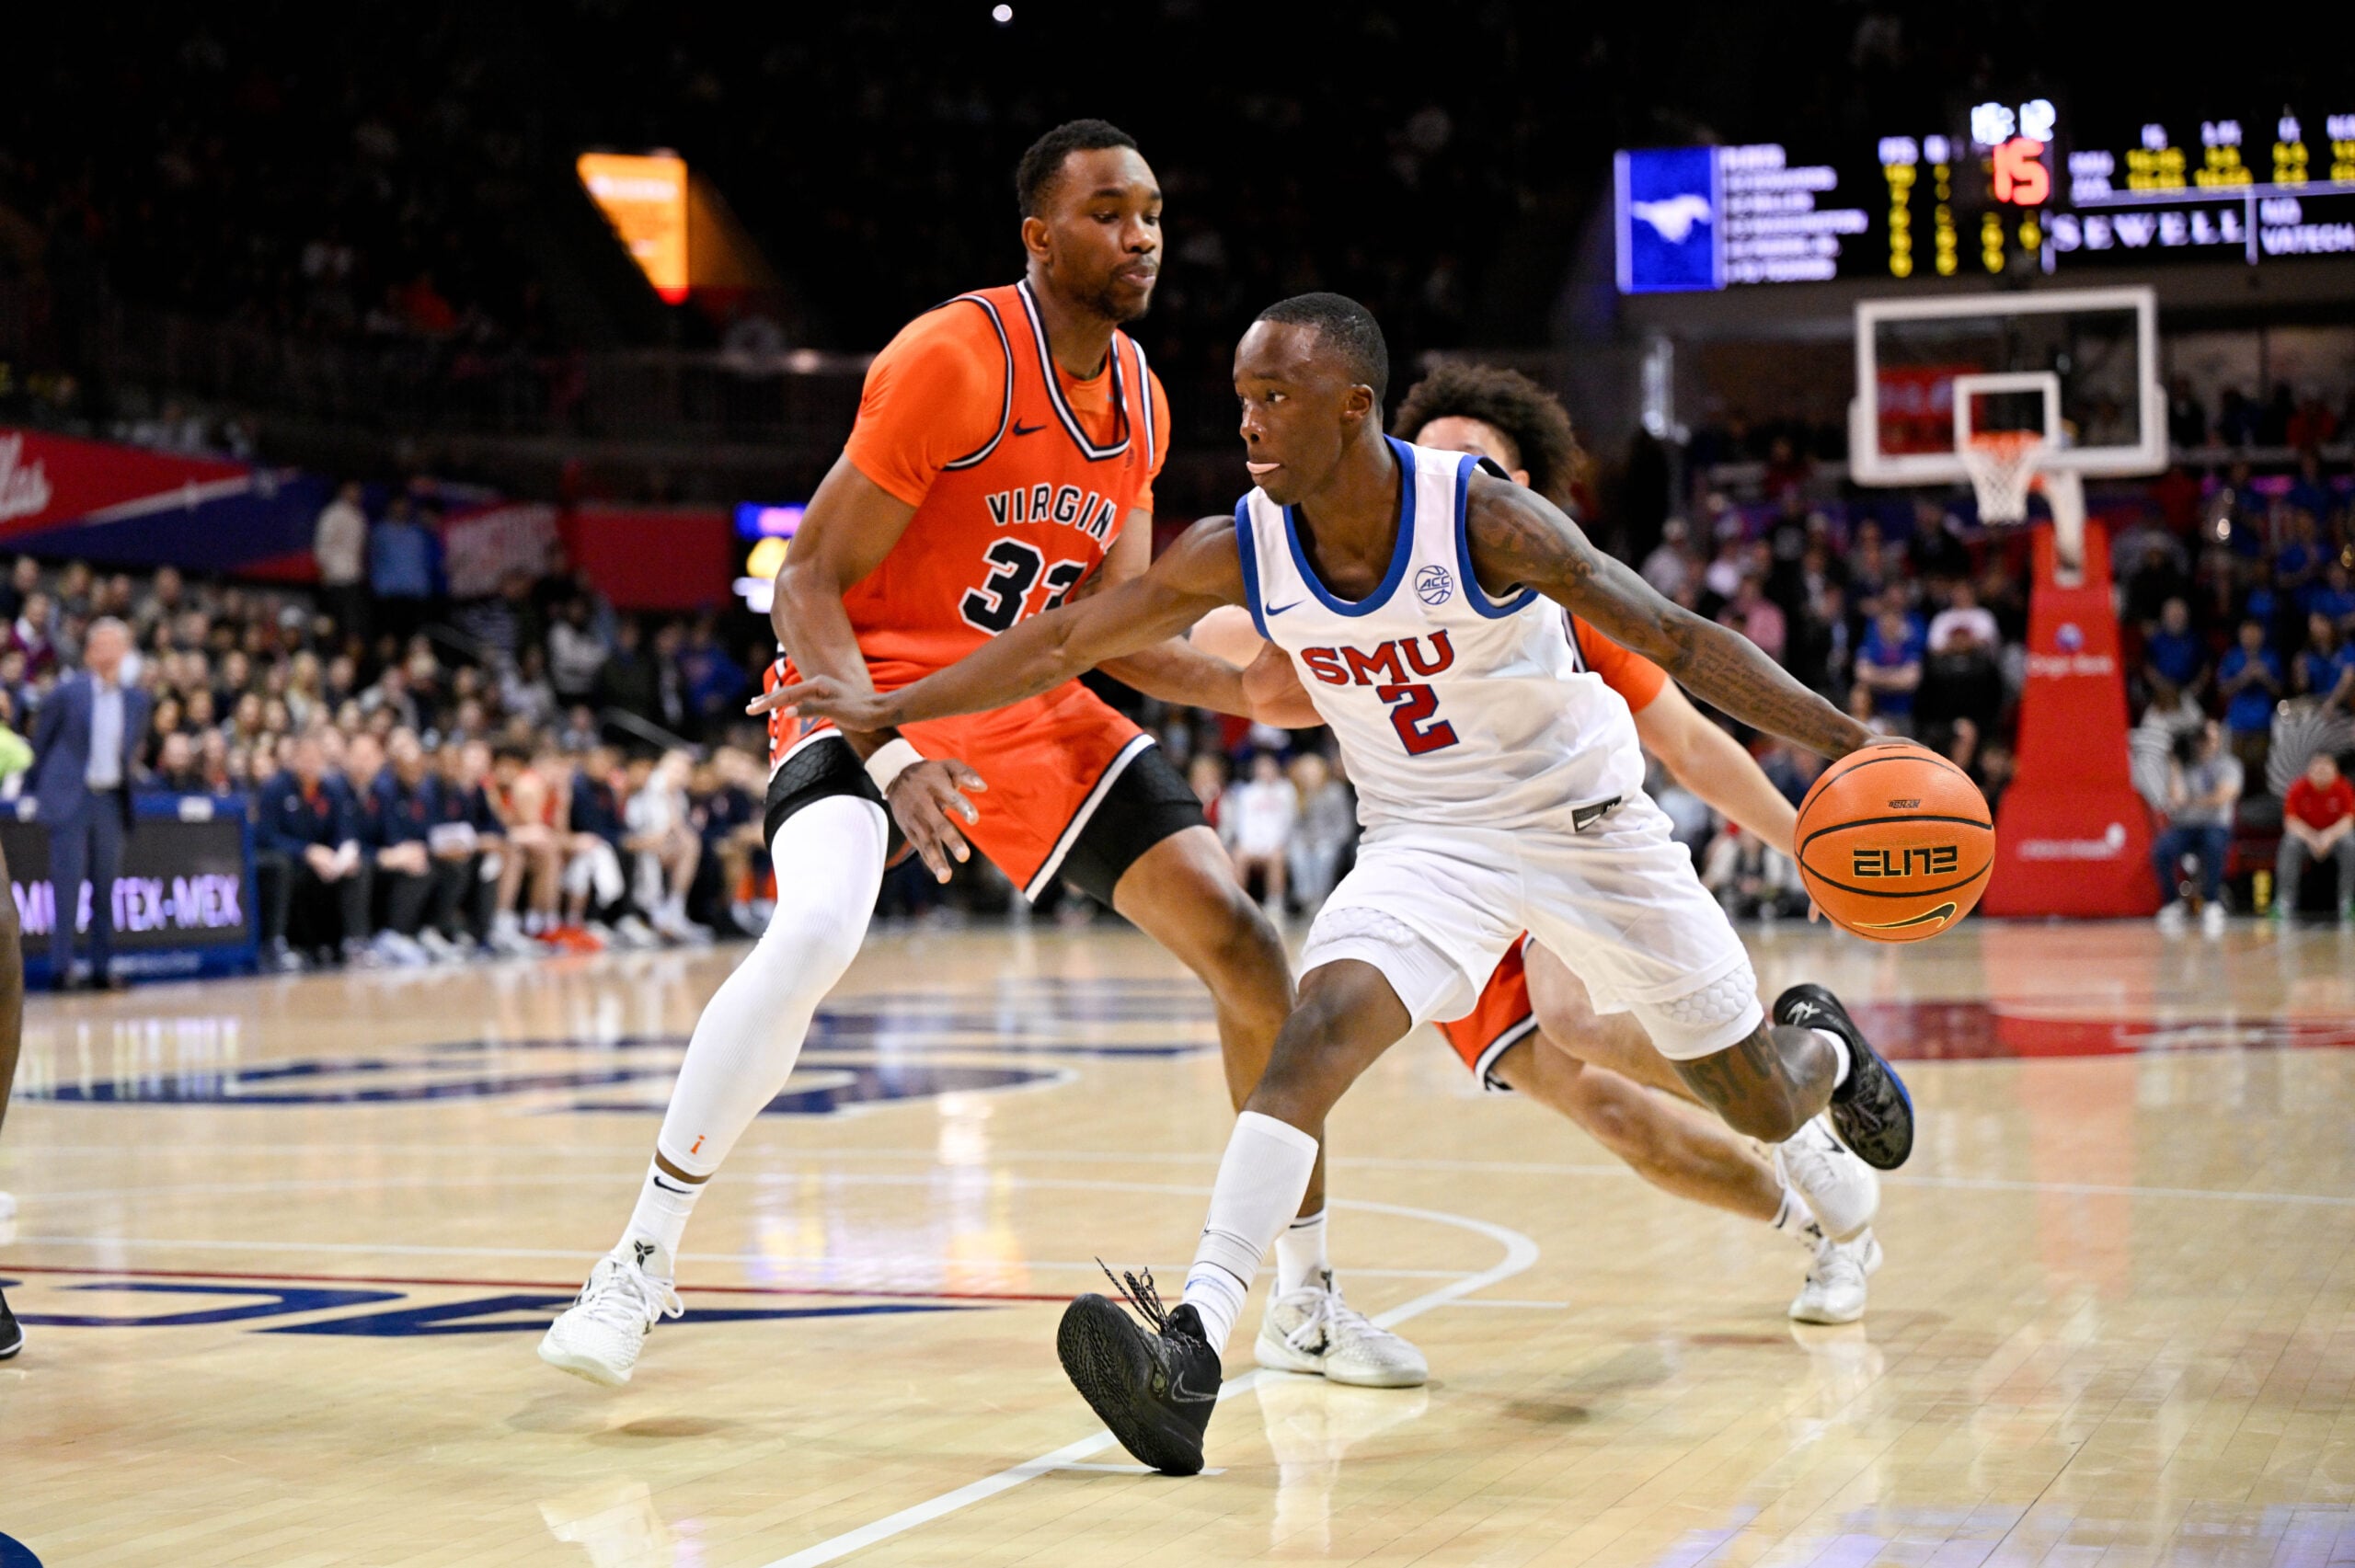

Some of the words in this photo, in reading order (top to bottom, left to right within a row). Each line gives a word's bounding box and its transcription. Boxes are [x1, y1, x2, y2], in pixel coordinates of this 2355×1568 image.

[1993, 137, 2051, 205] 15
[2050, 209, 2246, 252] SEWELL
[1419, 574, 1451, 590] ACC
[1301, 628, 1454, 685] SMU
[1375, 683, 1460, 756] 2
[1853, 844, 1958, 877] ELITE
[111, 875, 243, 932] TEX-MEX
